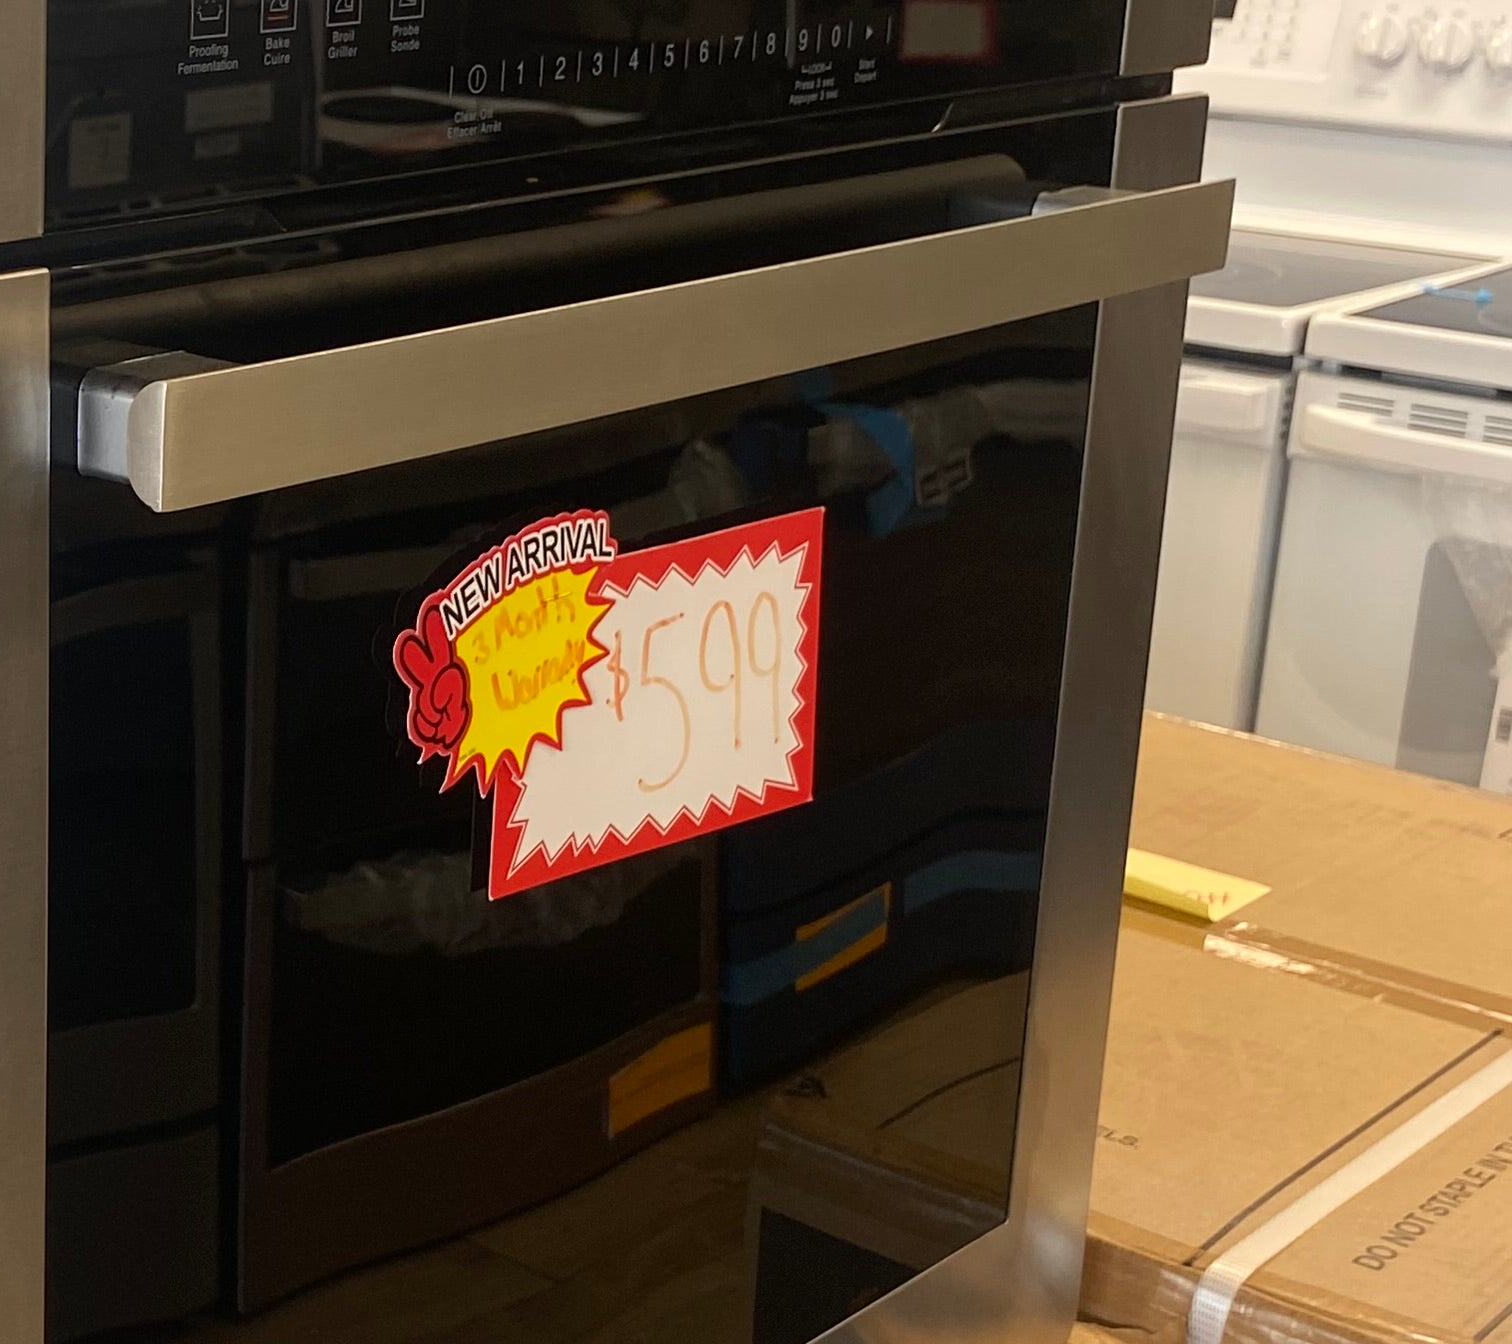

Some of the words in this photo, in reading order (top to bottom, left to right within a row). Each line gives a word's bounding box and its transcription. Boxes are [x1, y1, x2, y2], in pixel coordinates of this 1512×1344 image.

[332, 30, 355, 43] Broil
[392, 24, 420, 37] Probe
[265, 37, 290, 50] Bake
[391, 39, 420, 53] Sonde
[189, 44, 229, 58] Proofing
[328, 46, 358, 60] Griller
[516, 61, 524, 85] 1
[554, 56, 566, 80] 2
[592, 52, 603, 76] 3
[628, 47, 639, 71] 4
[664, 44, 674, 67] 5
[699, 39, 709, 63] 6
[734, 36, 744, 59] 7
[766, 32, 776, 55] 8
[798, 29, 808, 52] 9
[831, 25, 841, 48] 0
[177, 58, 238, 75] Fermentation
[263, 53, 290, 67] Cuire
[442, 557, 501, 636] NEW
[506, 522, 611, 587] ARRIVAL
[1352, 1244, 1398, 1271] DO
[1379, 1212, 1435, 1248] NOT
[1418, 1167, 1497, 1217] STAPLE
